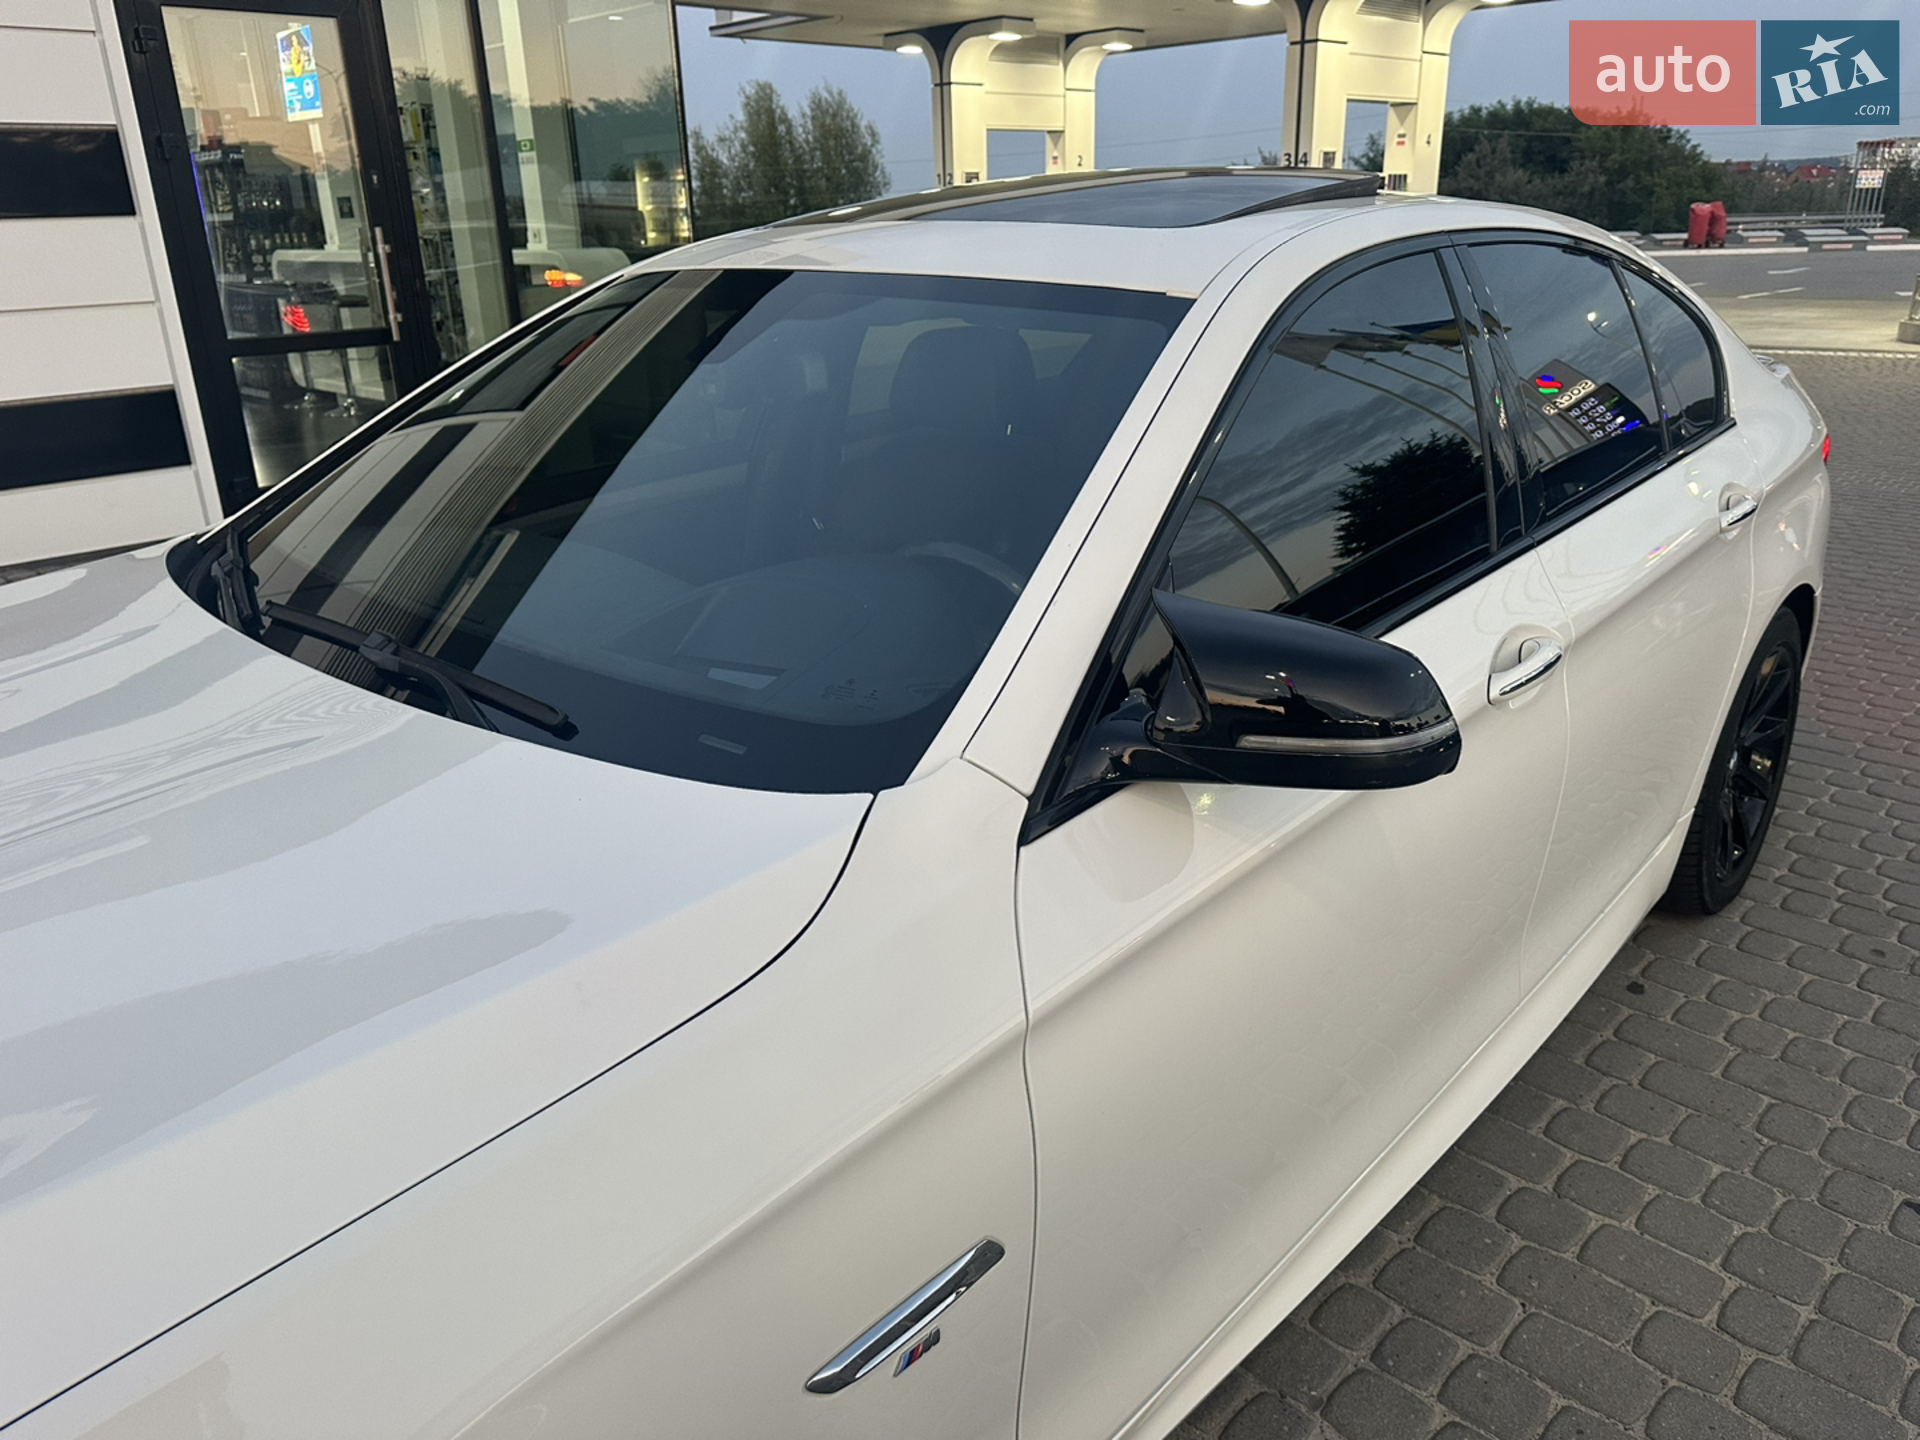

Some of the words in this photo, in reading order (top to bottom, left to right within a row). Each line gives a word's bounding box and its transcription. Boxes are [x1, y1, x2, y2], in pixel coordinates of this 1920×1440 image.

[1077, 155, 1083, 167] 2
[1283, 153, 1293, 167] 3
[1299, 152, 1309, 166] 4
[947, 173, 954, 185] 2
